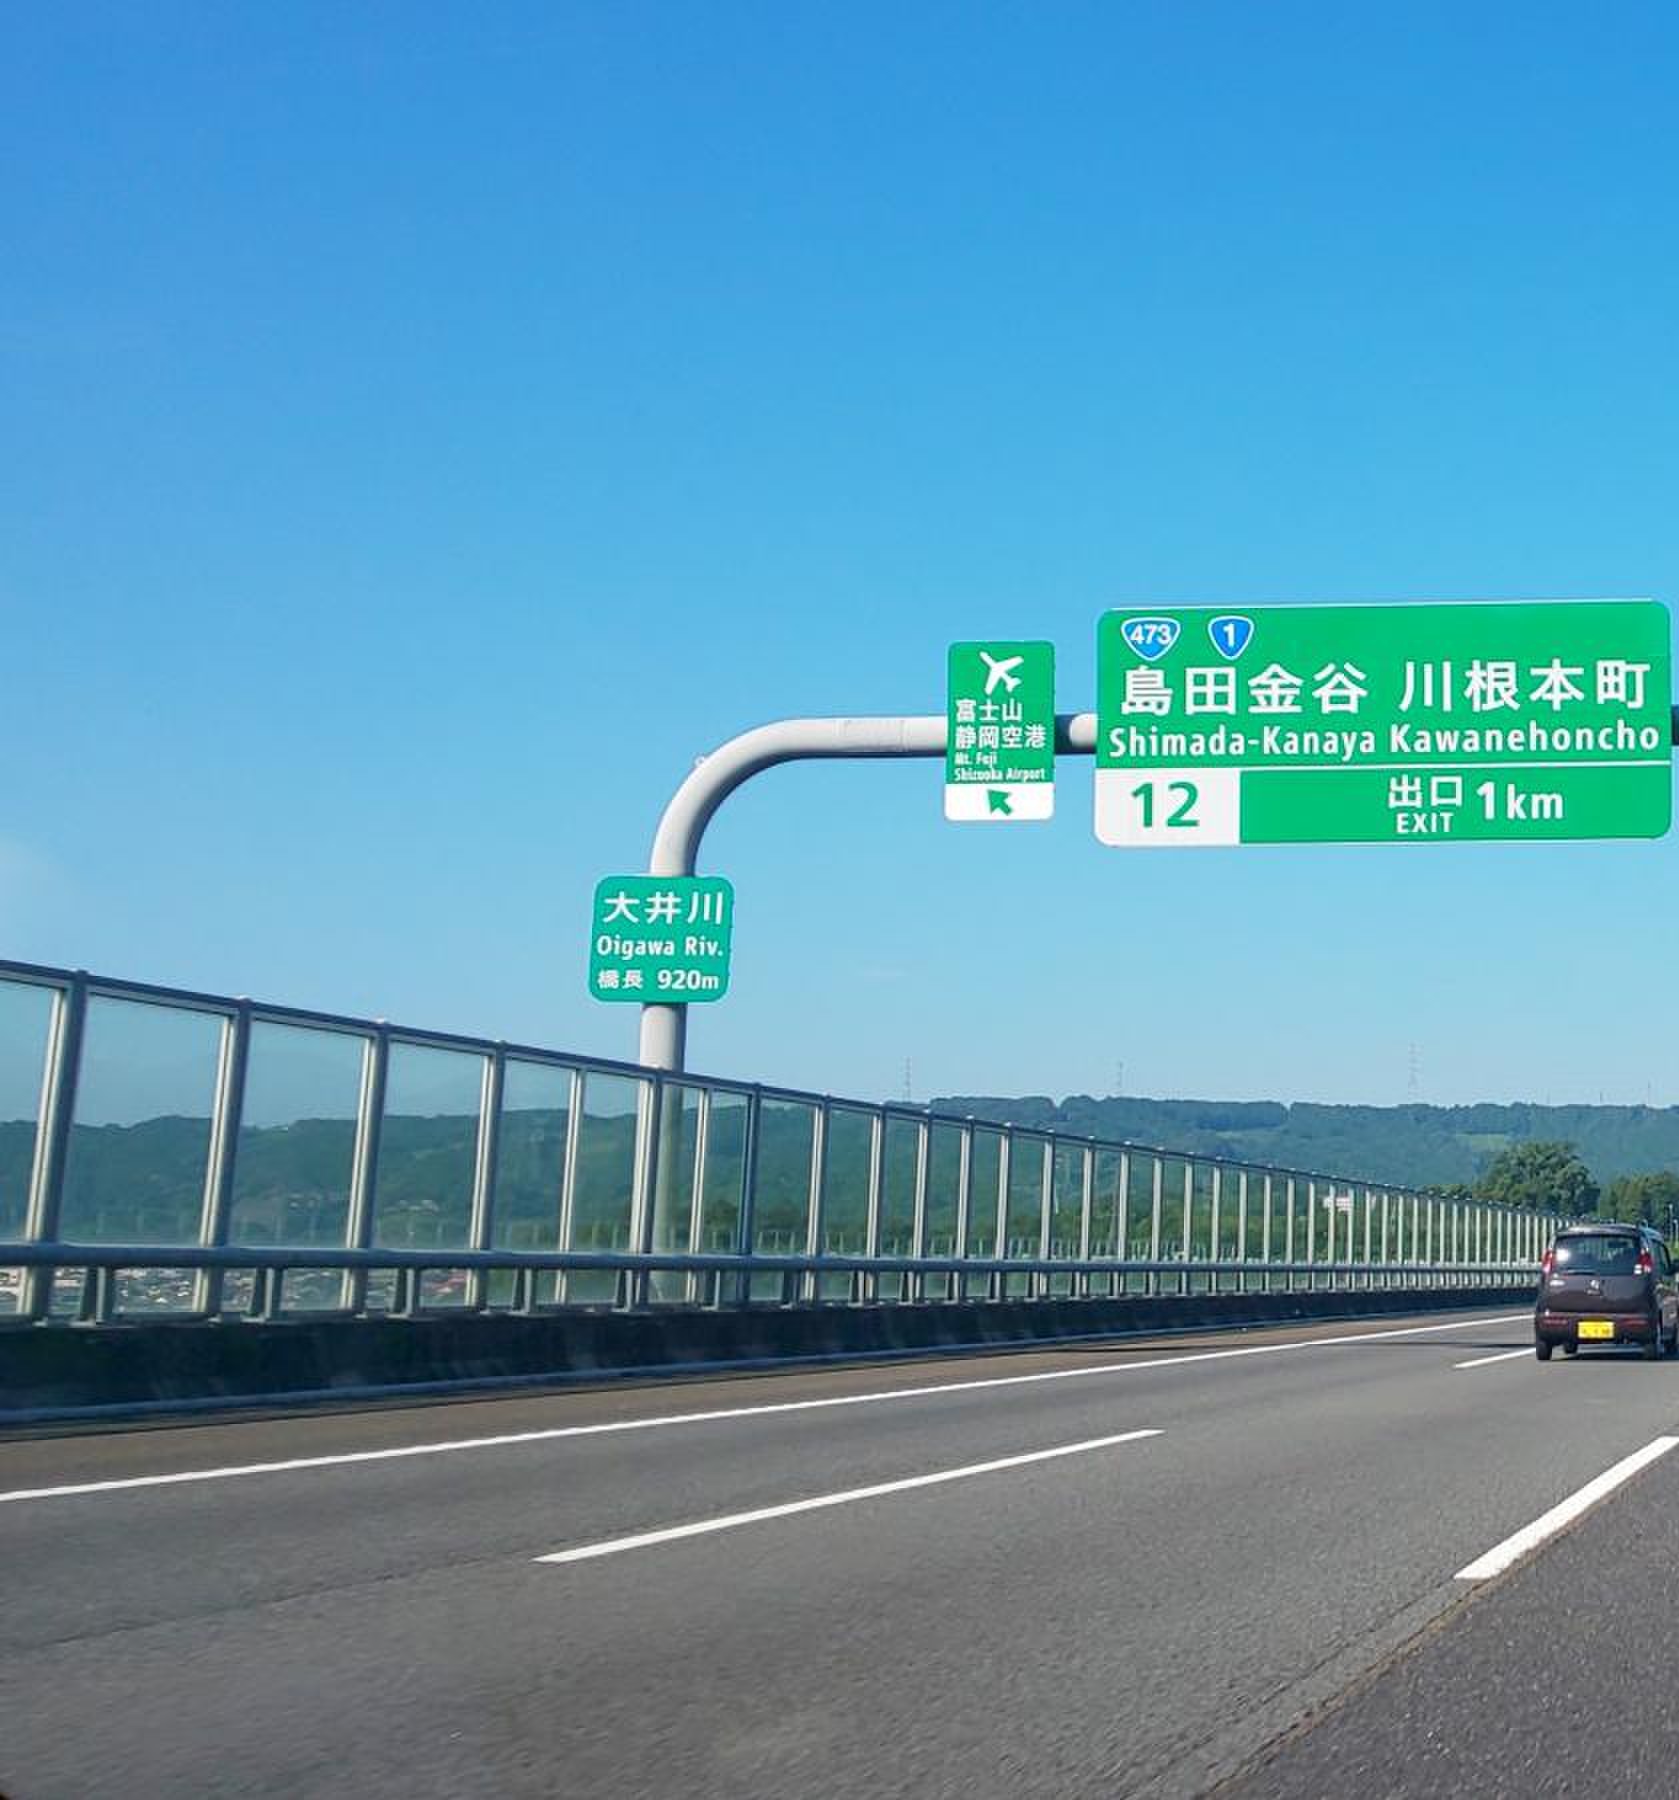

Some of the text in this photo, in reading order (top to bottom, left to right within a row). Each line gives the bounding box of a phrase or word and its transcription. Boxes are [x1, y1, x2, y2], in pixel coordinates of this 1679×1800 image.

[1130, 624, 1173, 645] 473
[1222, 623, 1236, 648] 1
[1120, 658, 1651, 716] 島田金谷 川根本町
[955, 698, 1023, 722] 富士山
[955, 724, 1047, 749] 静岡空港
[1109, 719, 1660, 761] Shimada-Kanaya Kawanehoncho
[1006, 768, 1046, 784] Airport
[1388, 774, 1464, 809] 出口
[1131, 781, 1200, 828] 12
[1396, 812, 1454, 833] EXIT
[603, 891, 723, 924] 大井川
[596, 934, 724, 960] Oigawa Riv.
[656, 969, 720, 990] 920m
